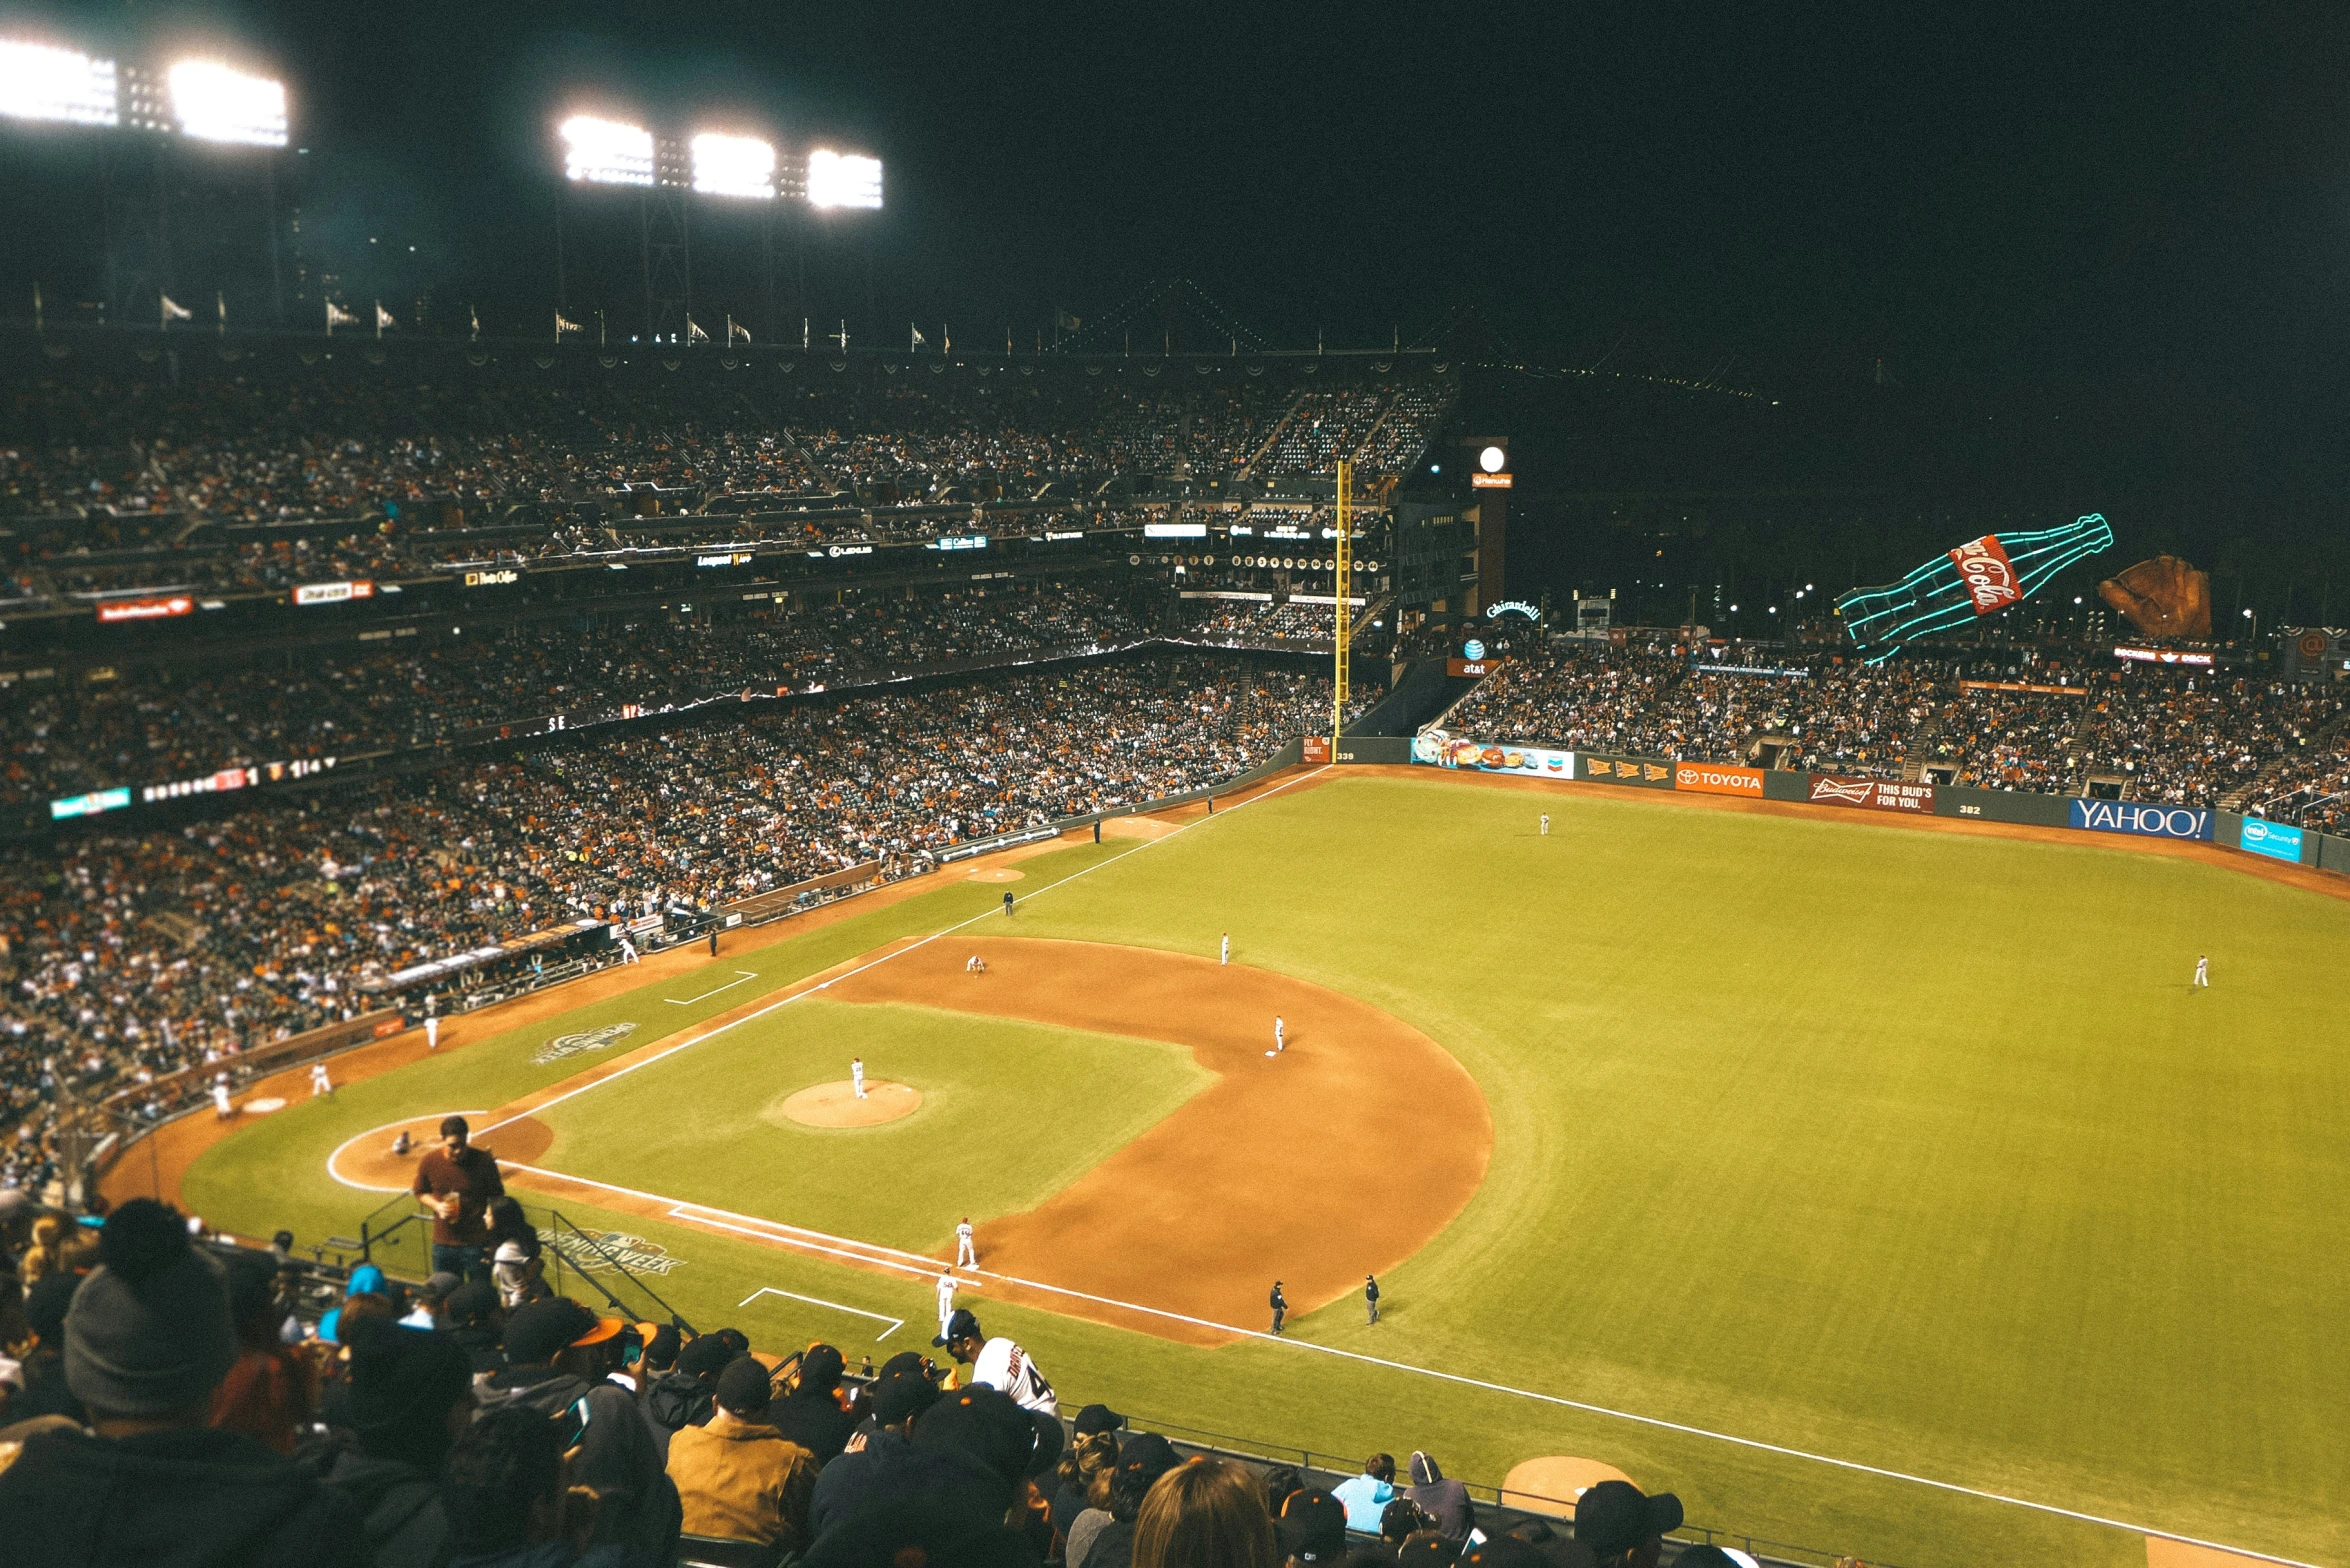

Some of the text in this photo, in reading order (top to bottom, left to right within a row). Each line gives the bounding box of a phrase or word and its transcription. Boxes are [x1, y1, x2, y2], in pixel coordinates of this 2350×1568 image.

[1486, 600, 1541, 620] Ghirardelli
[2181, 654, 2211, 664] DECK
[1463, 664, 1486, 674] at&t
[1701, 772, 1761, 789] TOYOTA
[1877, 783, 1932, 798] THIS BUD'S
[1876, 795, 1921, 809] FOR YOU.
[1959, 805, 1981, 815] 382
[2077, 800, 2207, 839] YAHOO!
[2268, 831, 2292, 844] Security
[615, 1249, 678, 1272] WEEK
